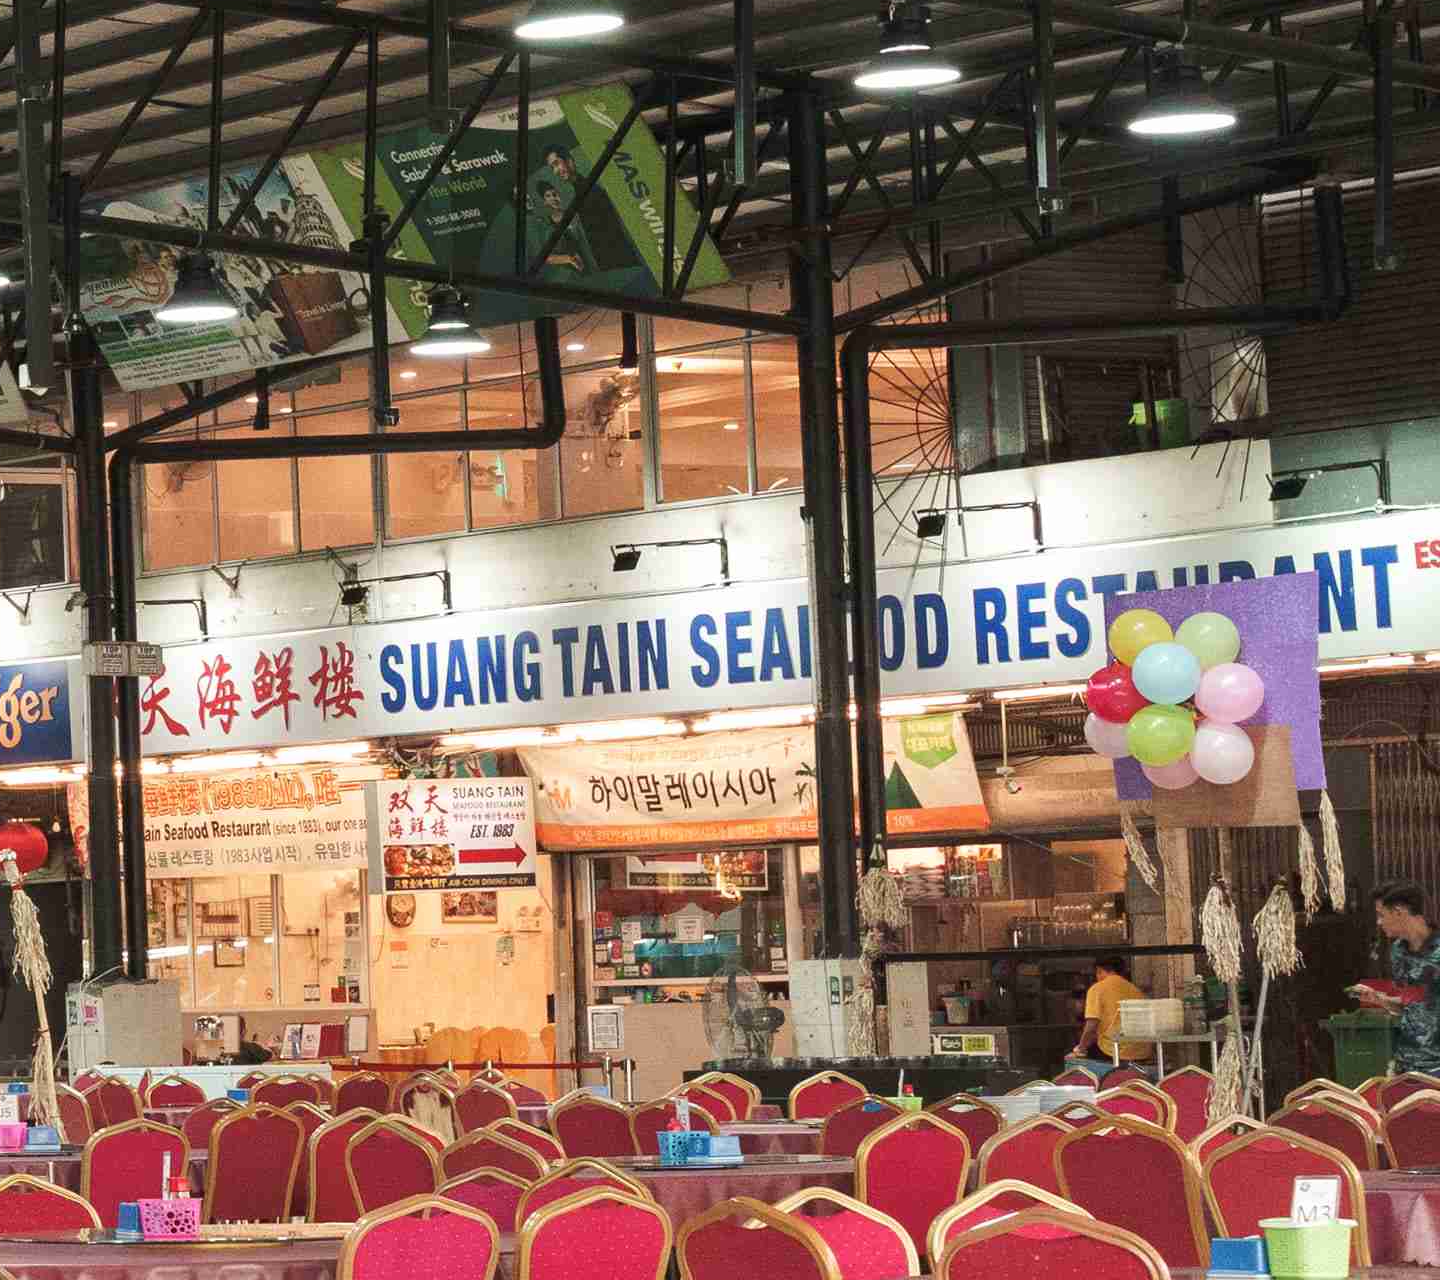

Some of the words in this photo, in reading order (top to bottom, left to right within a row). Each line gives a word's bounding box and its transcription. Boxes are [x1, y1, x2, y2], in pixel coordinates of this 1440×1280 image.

[451, 149, 508, 172] Sarawak
[380, 630, 544, 714] SUANG
[552, 618, 670, 697] TAIN
[690, 593, 950, 688] SEAOD
[141, 641, 365, 736] 天海鲜楼
[453, 786, 495, 800] SUANG
[498, 785, 524, 798] TAIN
[588, 767, 777, 812] 하이말레이시아
[144, 826, 161, 841] ain
[164, 820, 209, 840] Seafood
[211, 819, 272, 838] Restaurant
[492, 823, 515, 838] 1983
